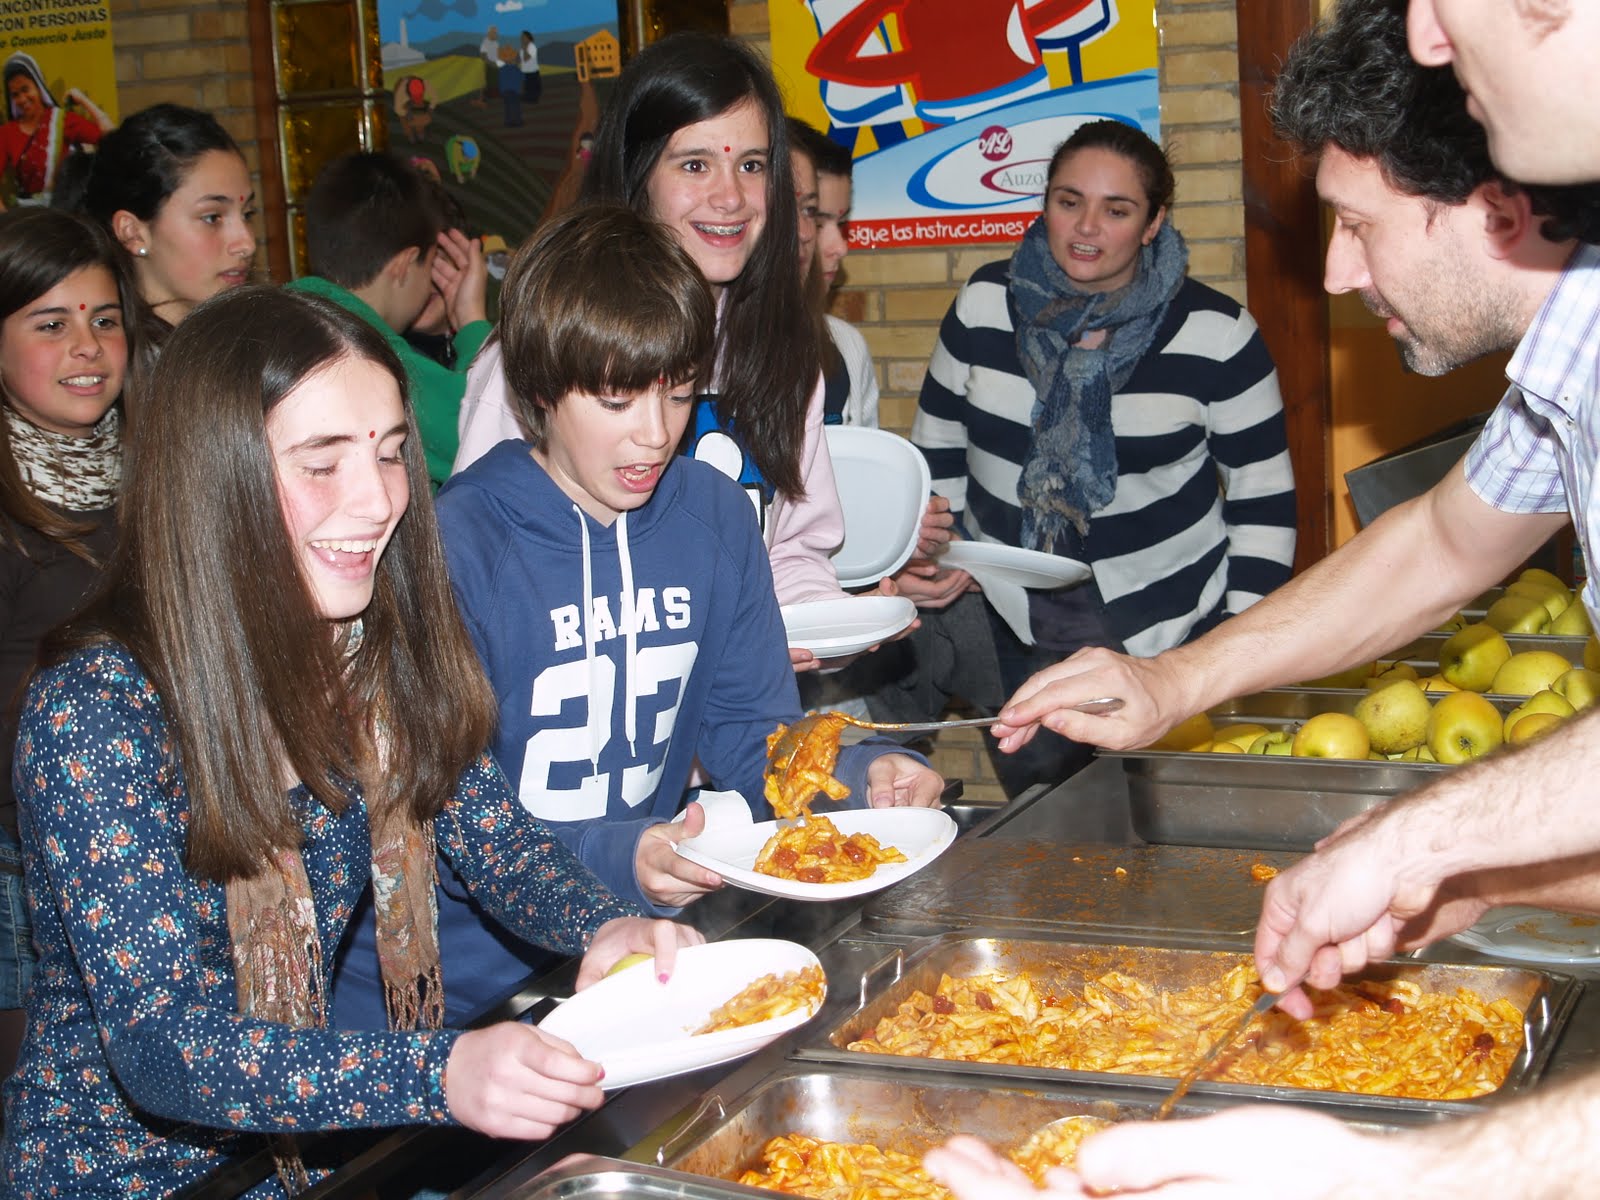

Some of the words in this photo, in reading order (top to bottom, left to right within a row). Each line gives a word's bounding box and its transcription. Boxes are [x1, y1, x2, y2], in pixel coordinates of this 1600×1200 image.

[29, 8, 107, 28] PERSONAS
[11, 33, 68, 47] Comercio
[71, 29, 106, 42] Justo
[1000, 170, 1047, 187] Auzo
[849, 225, 889, 246] sigue
[892, 223, 912, 240] las
[915, 219, 1025, 239] instrucciones
[550, 586, 691, 652] RAMS
[518, 641, 699, 822] 23
